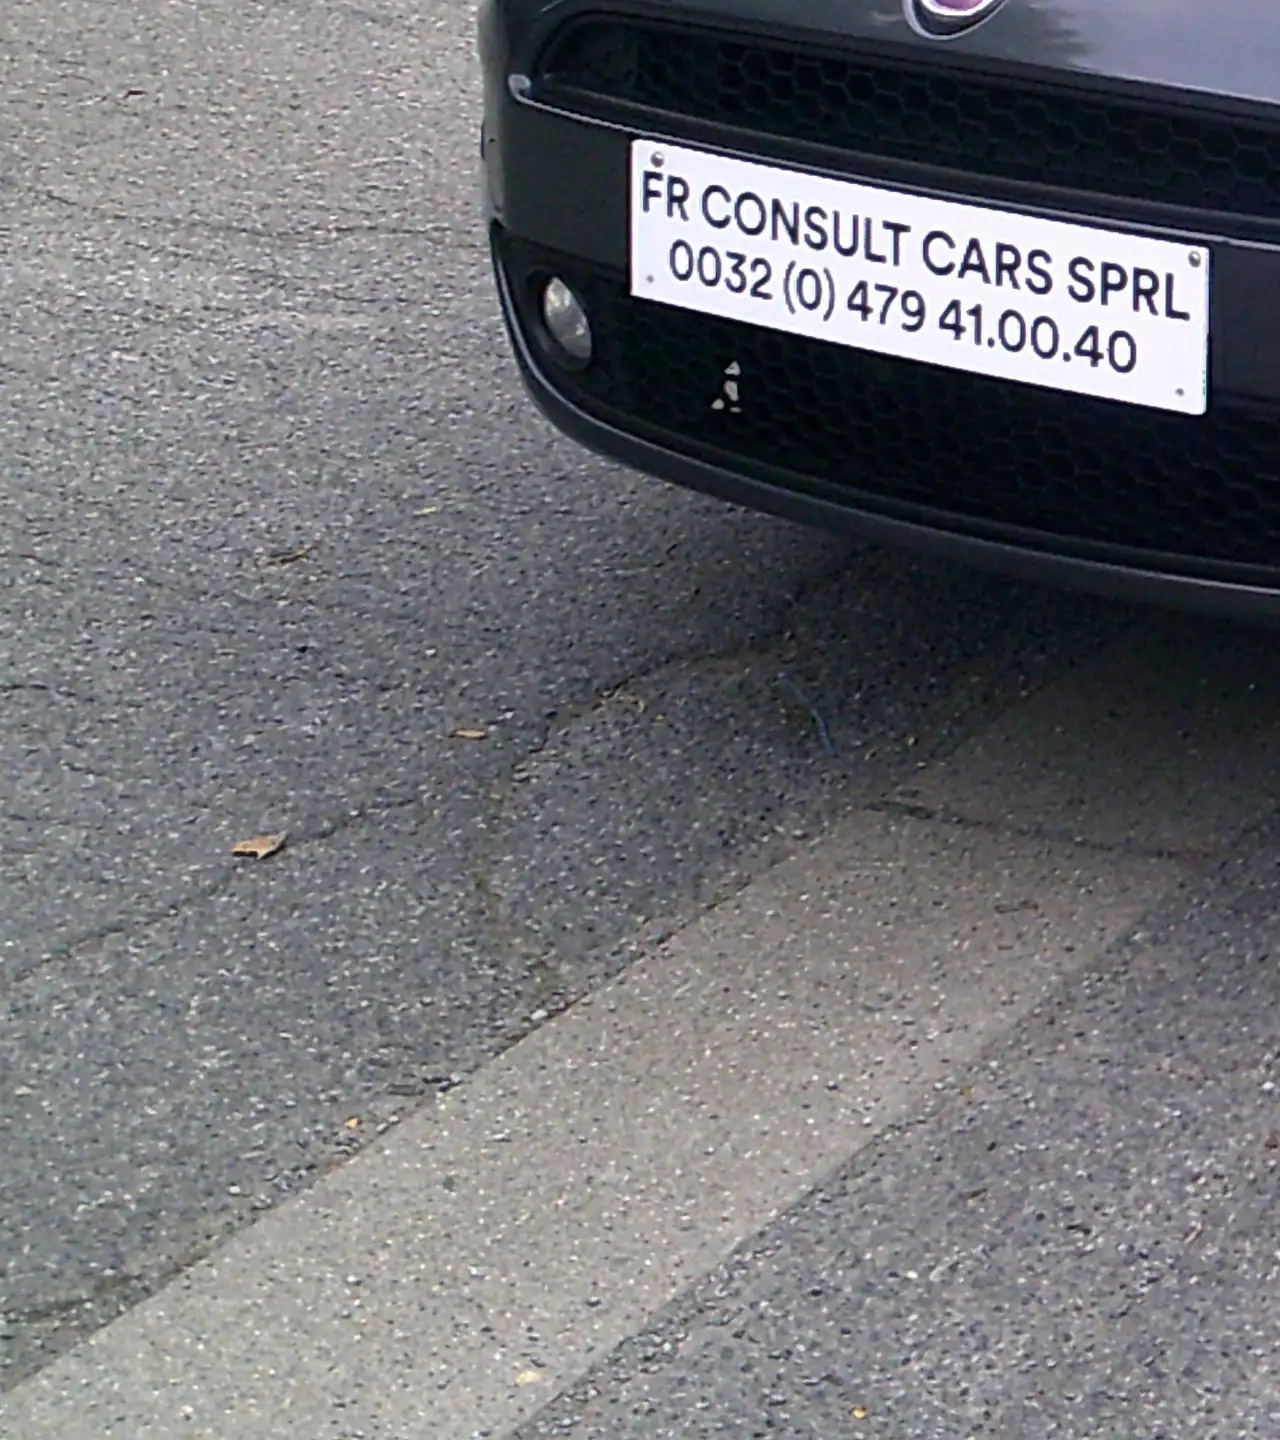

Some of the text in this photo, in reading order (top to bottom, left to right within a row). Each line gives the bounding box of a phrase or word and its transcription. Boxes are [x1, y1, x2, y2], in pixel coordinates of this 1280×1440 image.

[642, 170, 1191, 322] FR CONSULT CARS SPRL
[669, 238, 1137, 374] 0032 (0) 479 41.00.40
